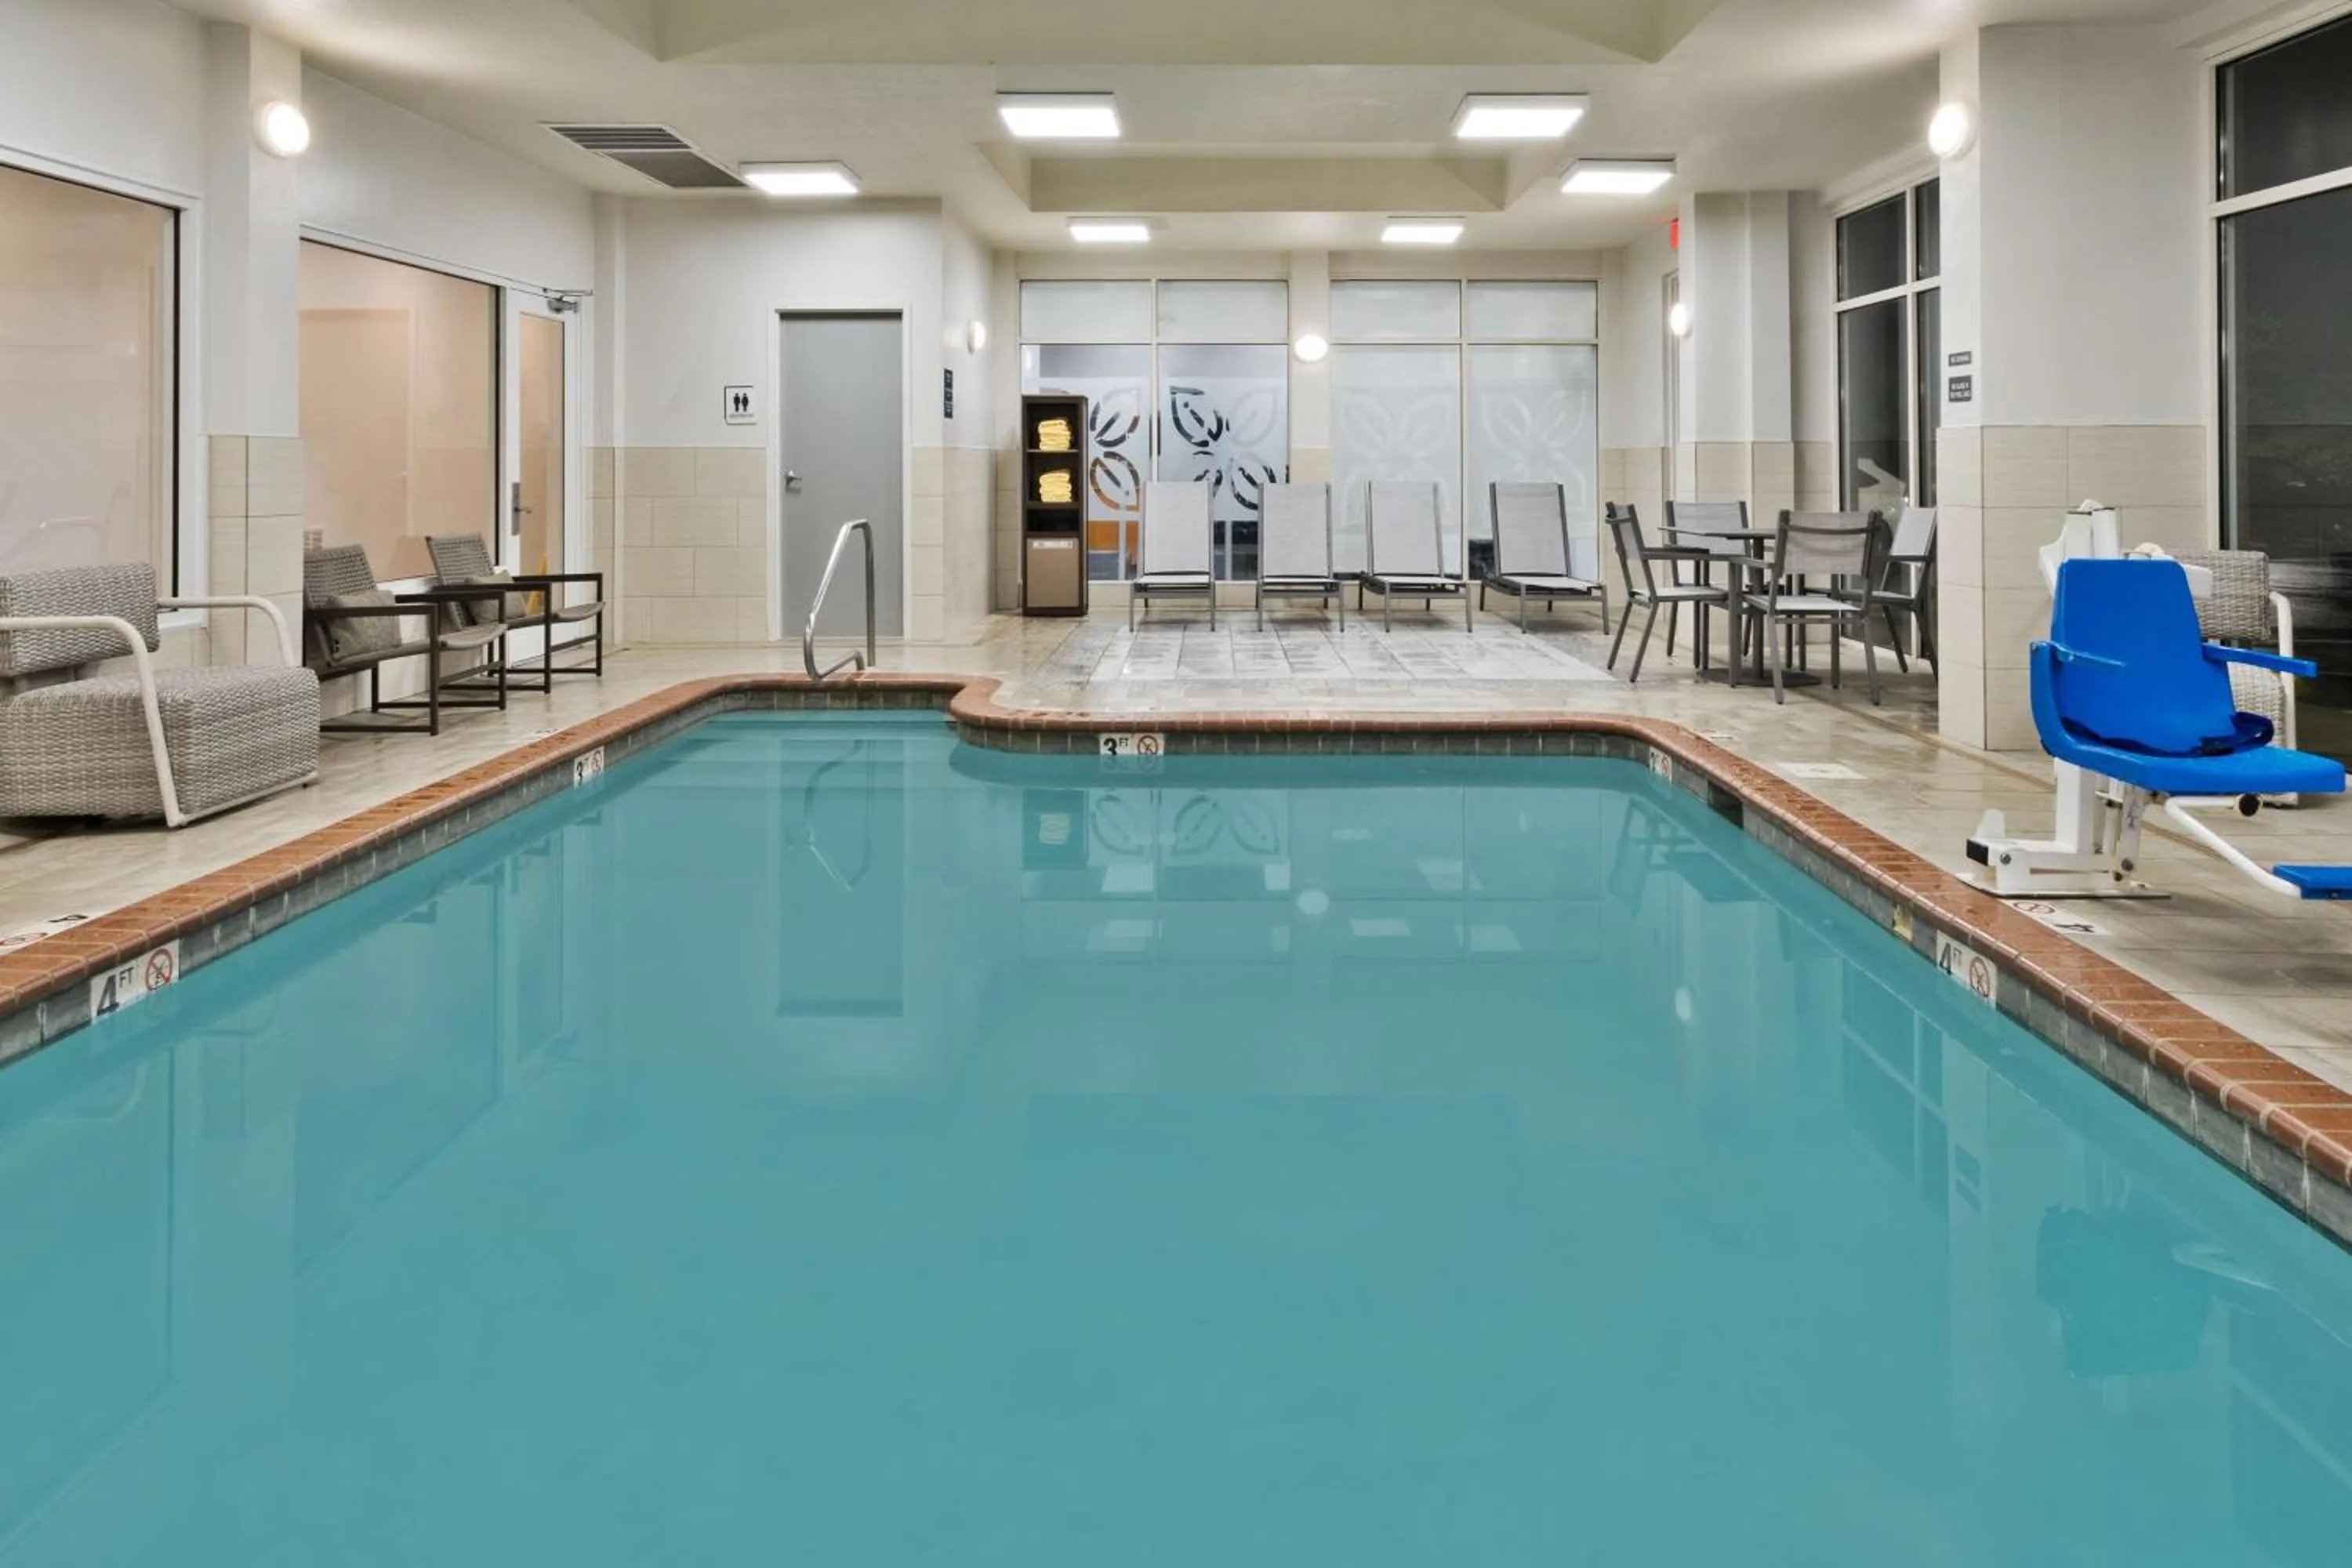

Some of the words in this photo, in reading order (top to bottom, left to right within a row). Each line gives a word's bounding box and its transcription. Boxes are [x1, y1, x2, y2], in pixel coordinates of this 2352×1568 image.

[1103, 738, 1117, 757] 3
[1119, 737, 1129, 747] FT
[1940, 942, 1952, 976] 4
[96, 975, 119, 1016] 4
[119, 967, 134, 989] FT
